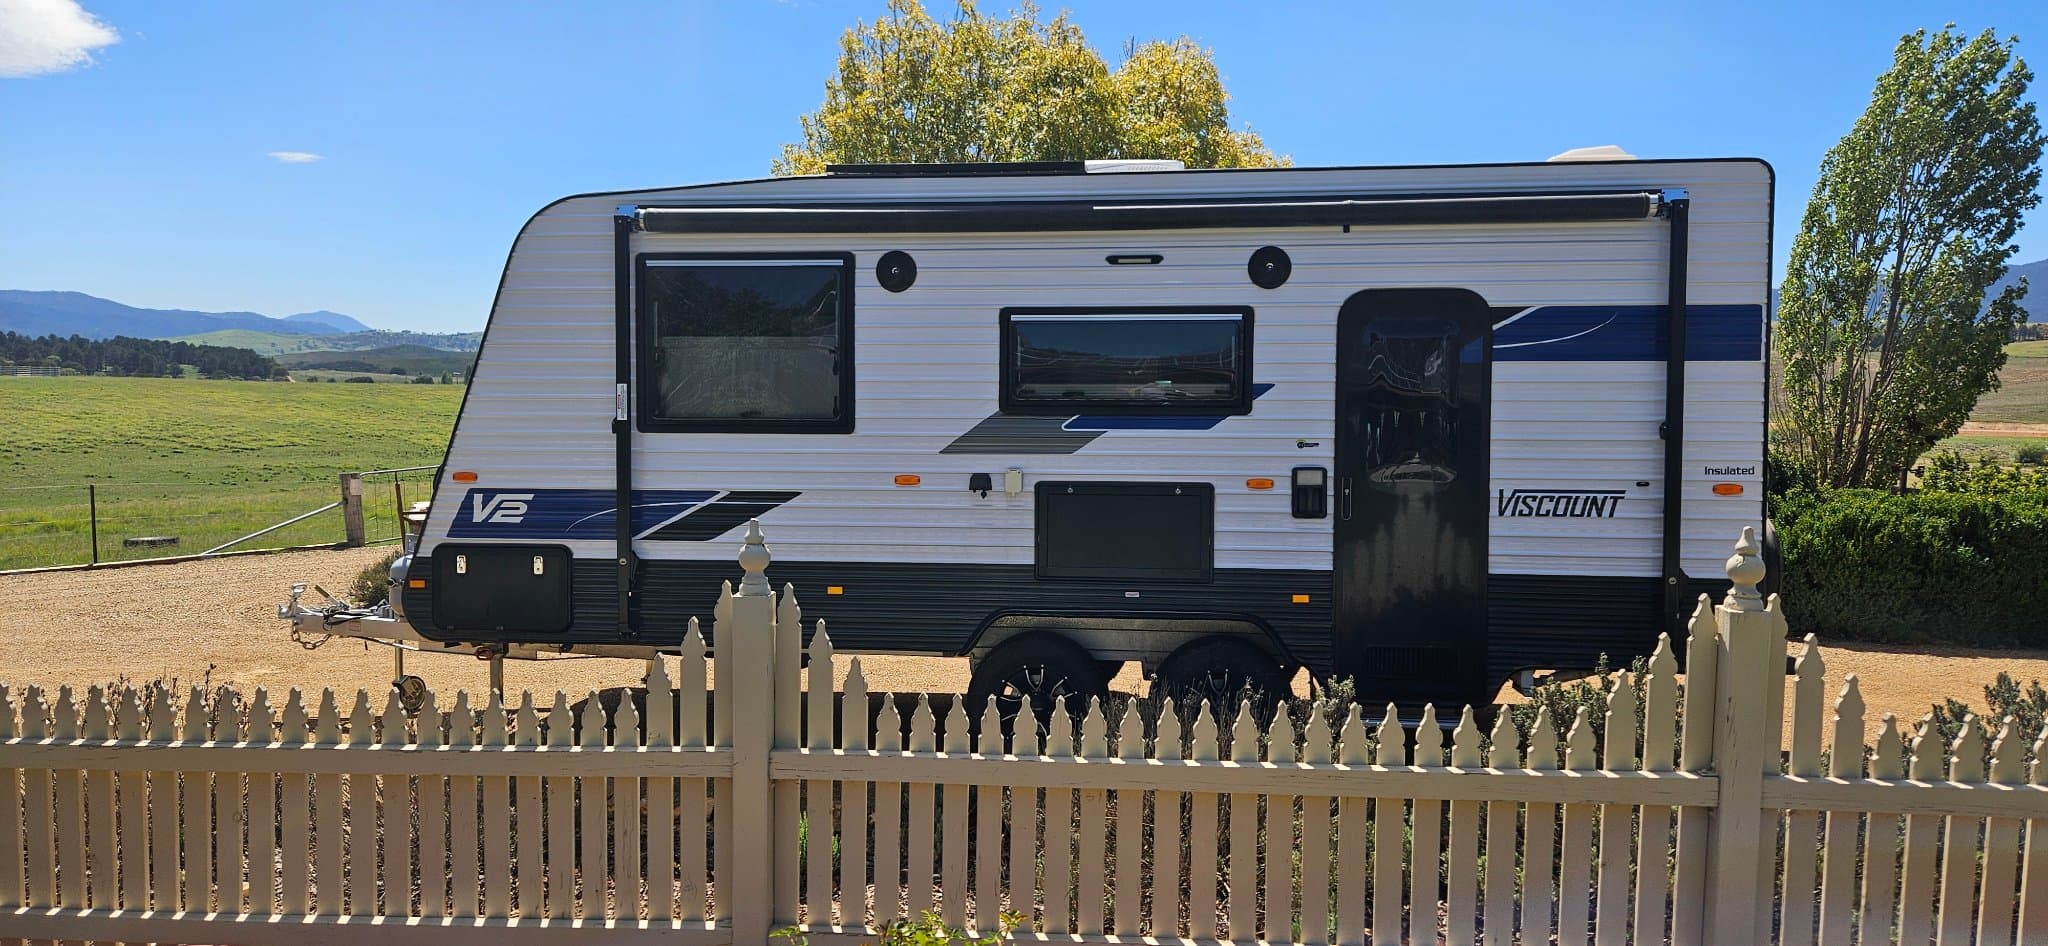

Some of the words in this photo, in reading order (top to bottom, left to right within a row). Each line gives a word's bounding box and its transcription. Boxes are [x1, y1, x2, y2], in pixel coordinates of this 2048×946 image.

[1704, 465, 1755, 475] Insulated
[472, 493, 535, 523] V2
[1498, 488, 1626, 517] VISCOUNT
